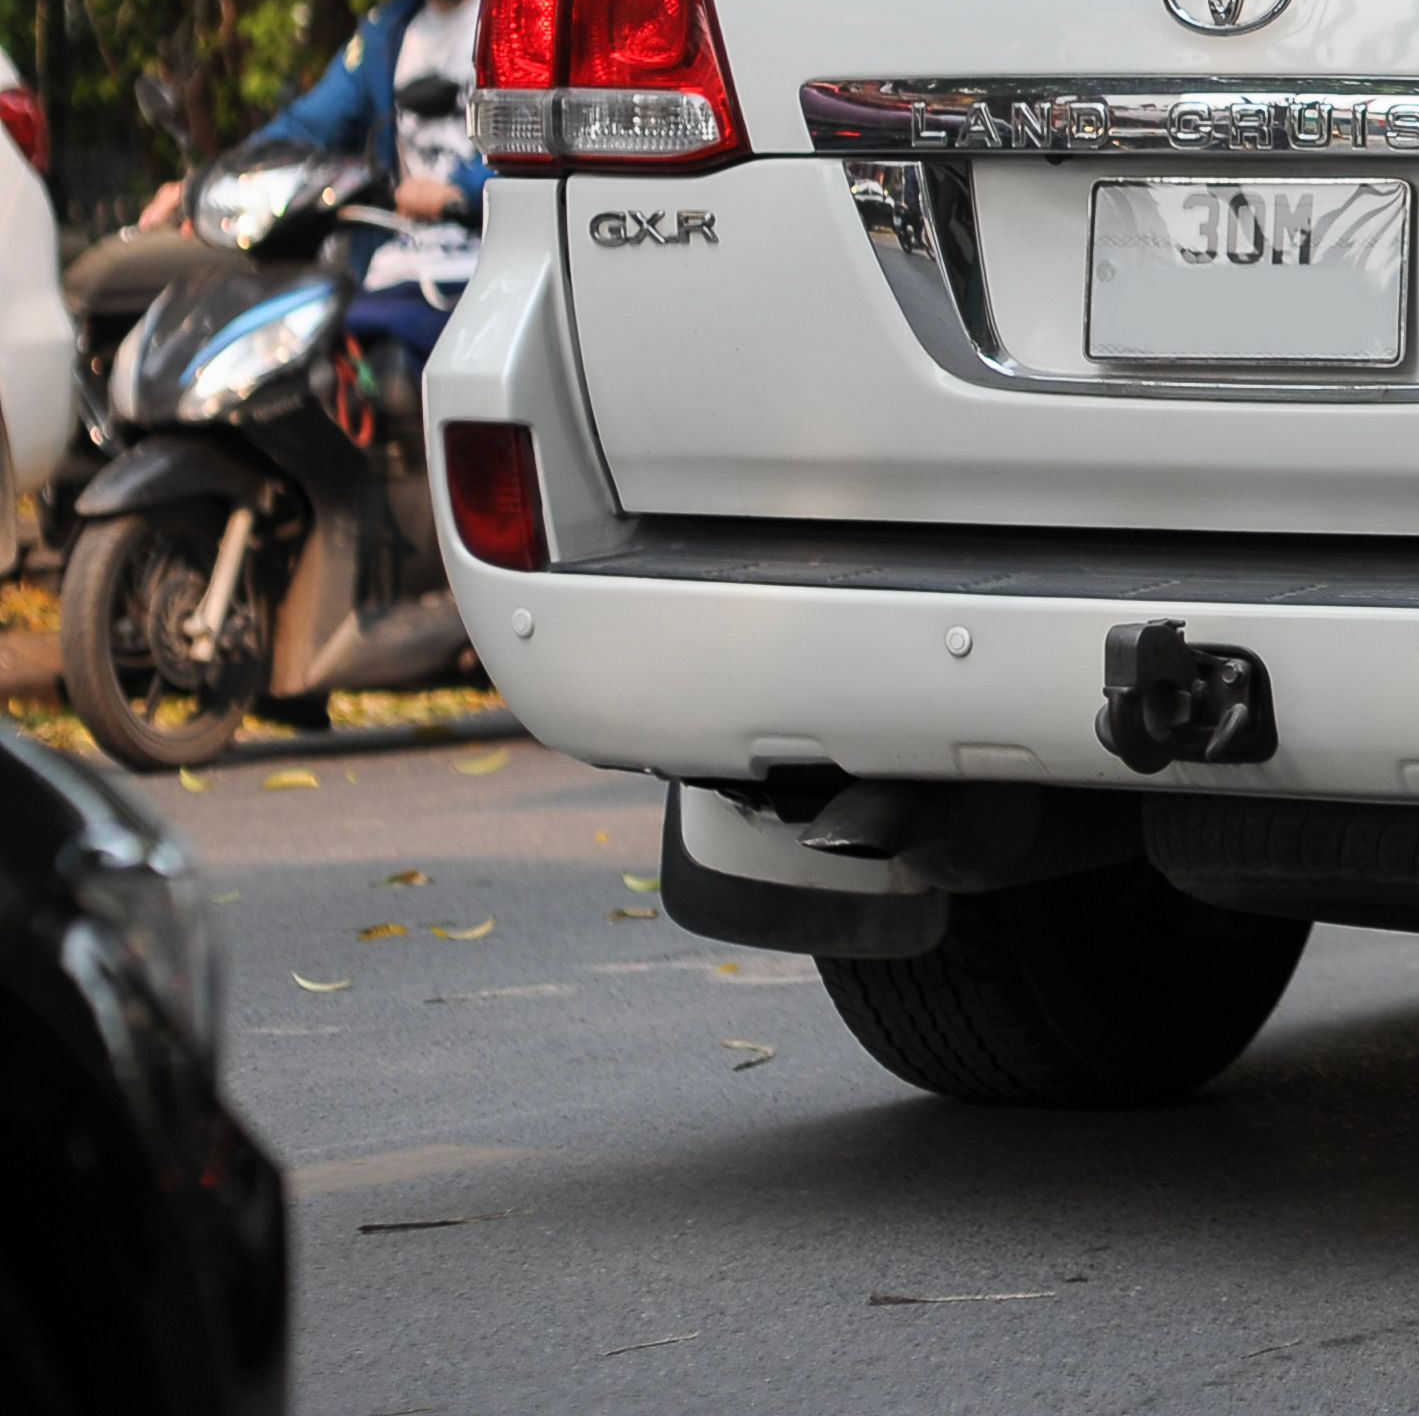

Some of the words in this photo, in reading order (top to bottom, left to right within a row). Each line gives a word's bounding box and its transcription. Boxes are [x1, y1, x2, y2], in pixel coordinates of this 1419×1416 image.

[910, 100, 1111, 150] LAND
[589, 209, 719, 247] GXR
[1178, 192, 1315, 265] 30M
